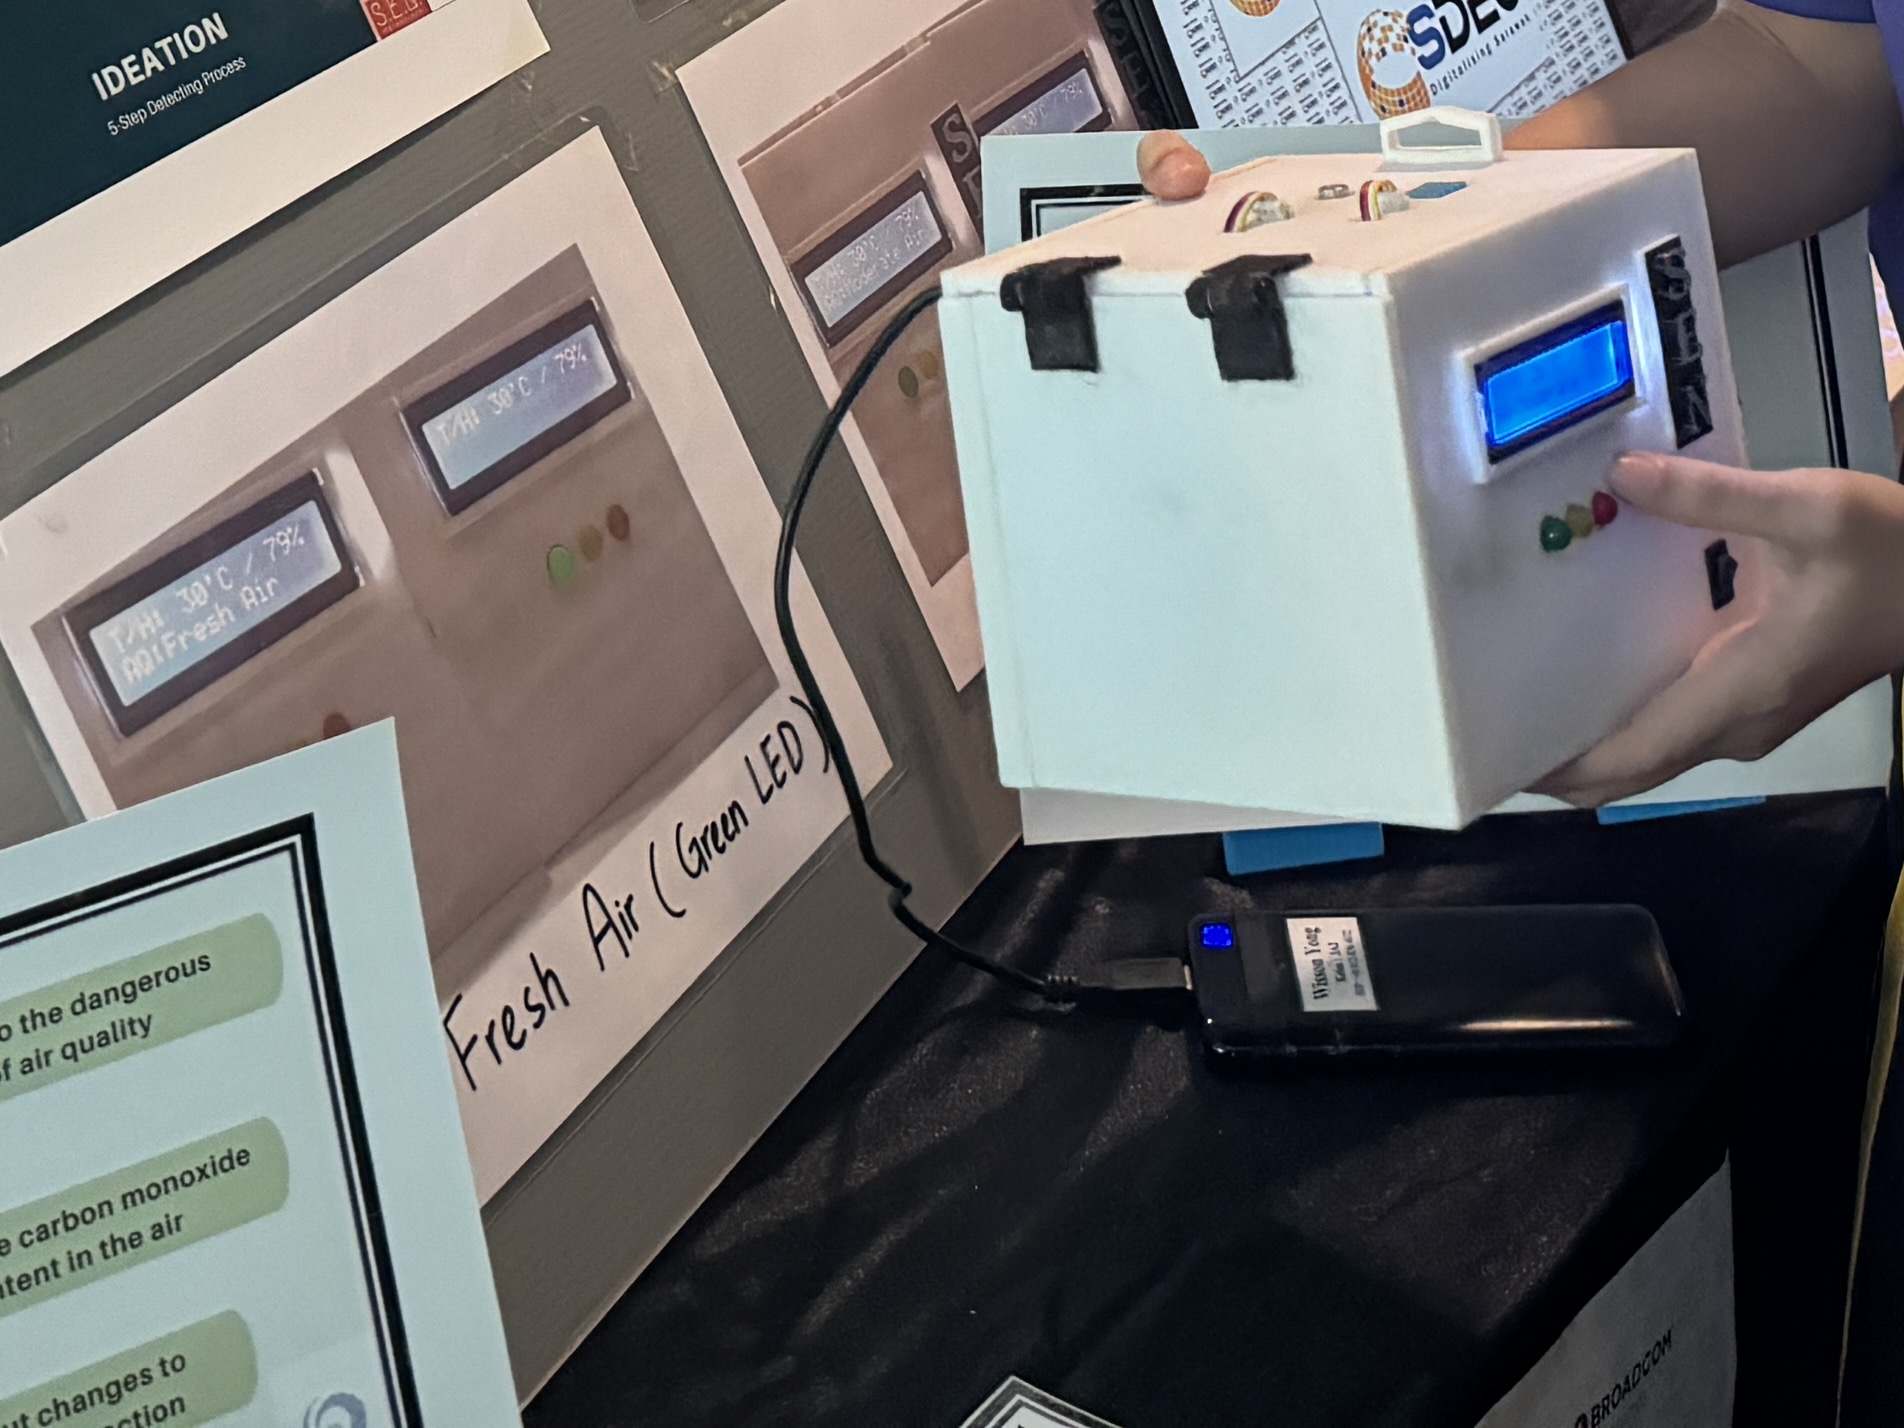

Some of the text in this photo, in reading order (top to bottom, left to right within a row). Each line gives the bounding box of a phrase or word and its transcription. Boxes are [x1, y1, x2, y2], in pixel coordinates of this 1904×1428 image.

[91, 11, 229, 101] IDEATION
[1493, 13, 1531, 48] Sarawak
[107, 56, 247, 136] 5-Step Detecting Process
[553, 342, 588, 375] 79%
[262, 524, 305, 563] 79%
[239, 575, 279, 612] Air
[441, 951, 570, 1092] Fresh
[582, 882, 640, 972] Air
[744, 694, 832, 805] LED)
[18, 1004, 64, 1036] the
[69, 952, 213, 1018] dangerous
[19, 1046, 54, 1076] air
[60, 1012, 155, 1064] quality
[18, 1197, 115, 1249] carbon
[119, 1145, 252, 1213] monoxide
[66, 1245, 95, 1274] in
[98, 1228, 144, 1261] the
[150, 1210, 185, 1242] air
[36, 1353, 186, 1428] changes to
[101, 1395, 186, 1428] ction
[1589, 1327, 1675, 1428] BROADCOM
